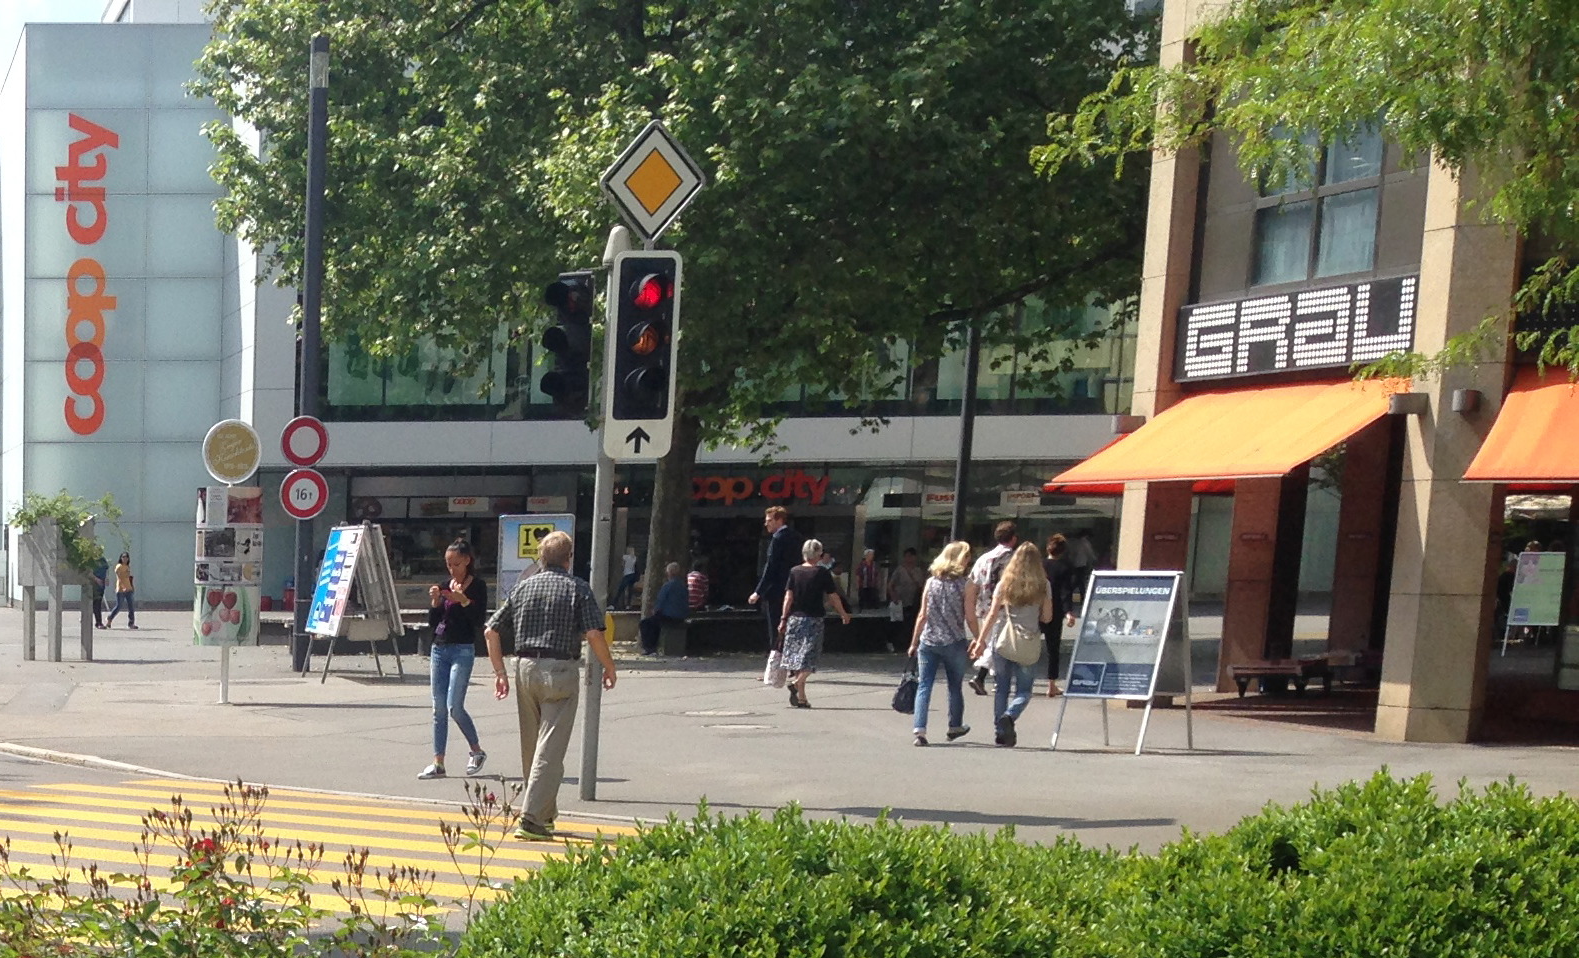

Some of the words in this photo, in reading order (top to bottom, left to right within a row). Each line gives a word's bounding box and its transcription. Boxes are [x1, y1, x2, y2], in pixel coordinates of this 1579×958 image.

[55, 113, 119, 245] city
[64, 258, 117, 435] coop
[295, 488, 308, 501] 16
[692, 476, 754, 506] oop
[761, 469, 831, 506] city
[1095, 585, 1171, 595] ÜBERSPIELUNGEN
